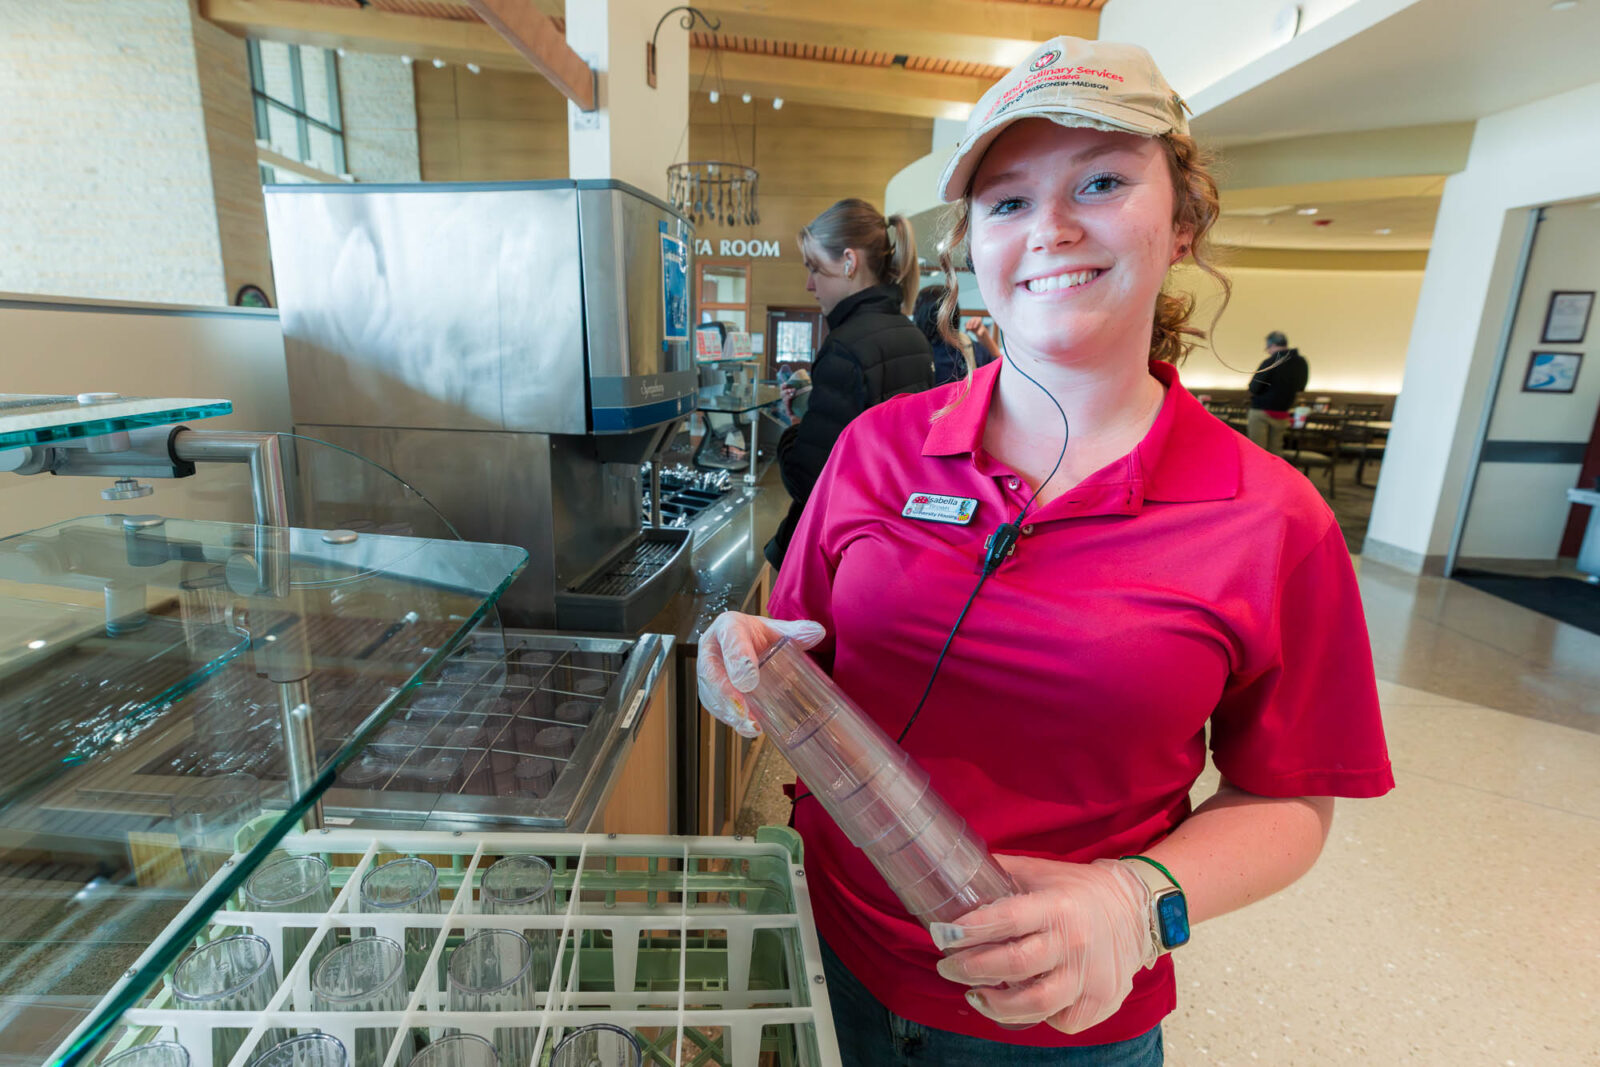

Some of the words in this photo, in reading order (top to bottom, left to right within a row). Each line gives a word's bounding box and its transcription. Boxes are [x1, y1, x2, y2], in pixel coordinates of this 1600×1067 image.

[1003, 80, 1022, 98] and
[1024, 67, 1074, 83] Culinary
[1076, 66, 1124, 82] Services
[720, 239, 780, 257] ROOM
